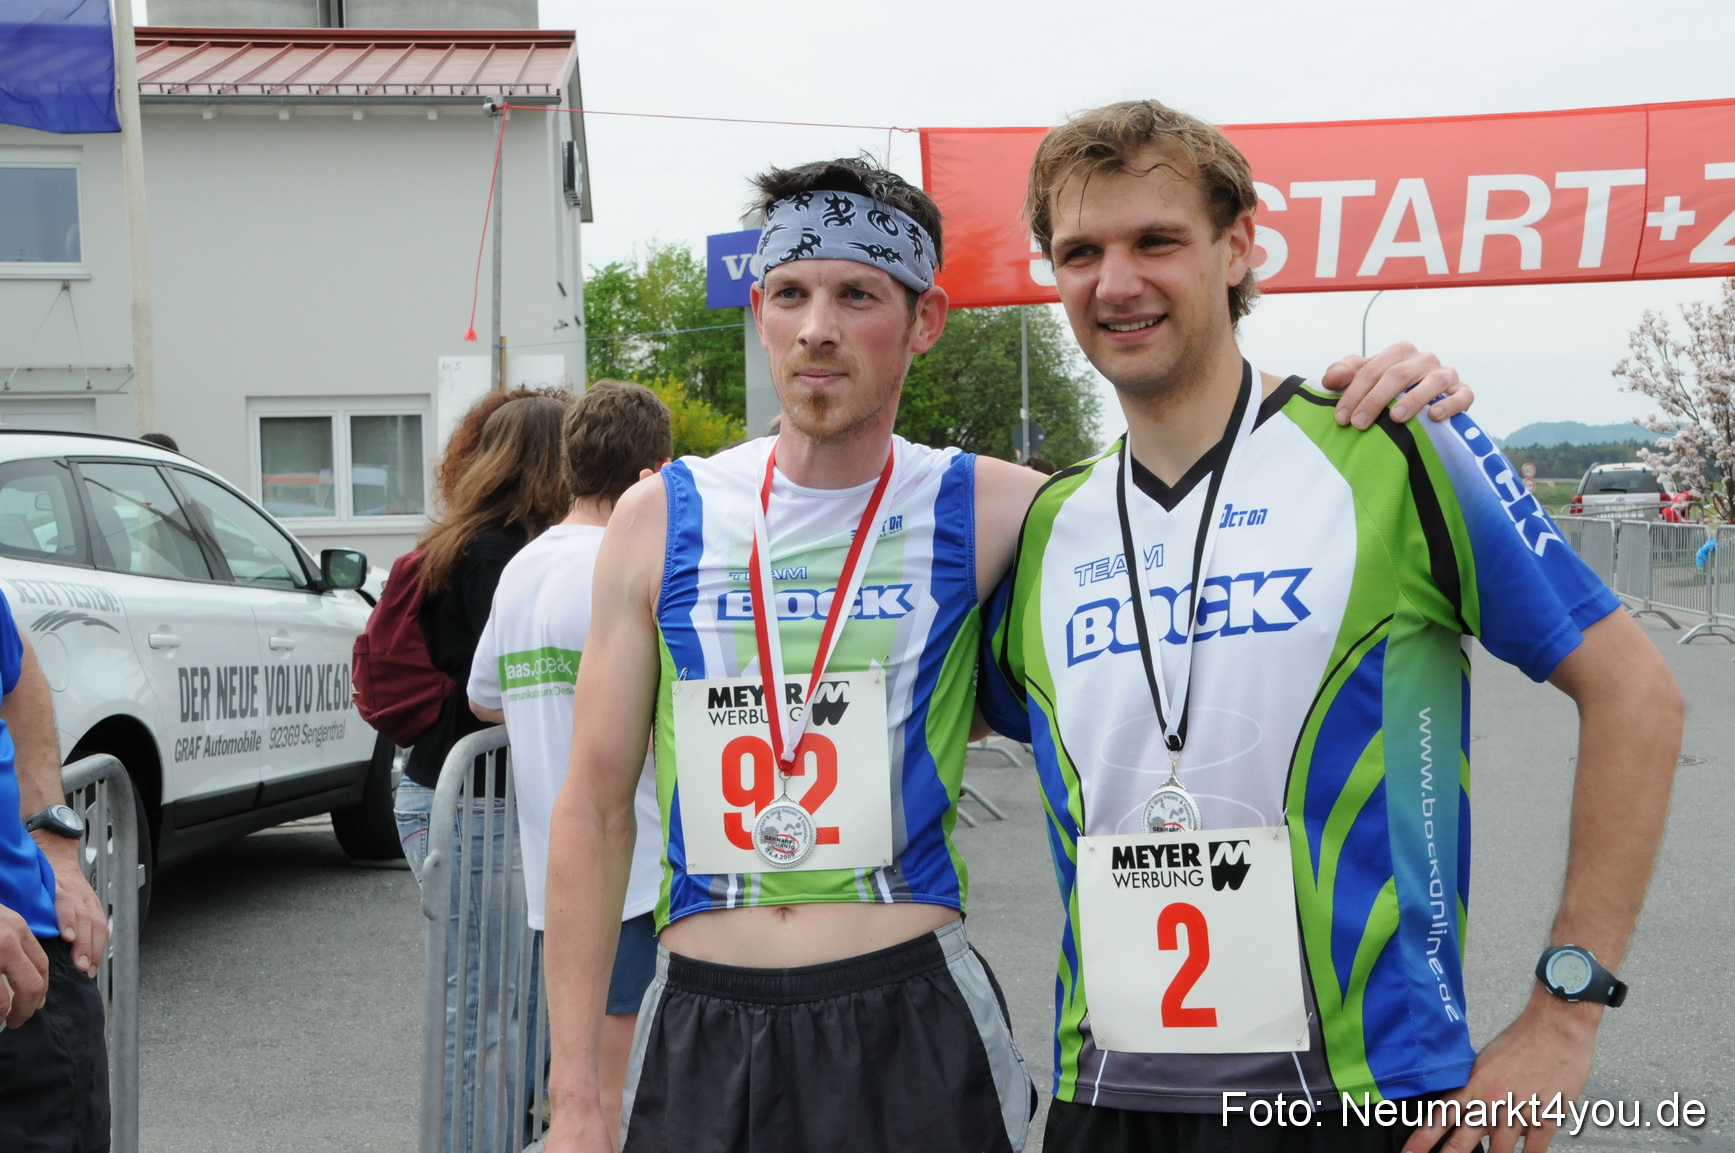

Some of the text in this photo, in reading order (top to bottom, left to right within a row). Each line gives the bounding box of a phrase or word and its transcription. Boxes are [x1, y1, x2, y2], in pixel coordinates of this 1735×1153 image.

[1450, 411, 1564, 558] OCK
[729, 566, 807, 581] TAM
[1074, 543, 1164, 587] TEAM
[1066, 567, 1313, 668] BOCK
[178, 667, 211, 722] DER
[216, 666, 259, 720] NEUE
[264, 664, 313, 716] VOLVO
[708, 682, 804, 709] MEYR
[708, 706, 805, 726] WERBUG
[174, 719, 346, 763] GRAF Automobile 92369 Sengenthal
[721, 733, 840, 850] 92
[1111, 843, 1203, 870] MEYER
[1418, 707, 1460, 1023] www.bockonline.de
[1112, 869, 1204, 889] WERBUNG
[1156, 902, 1218, 1028] 2
